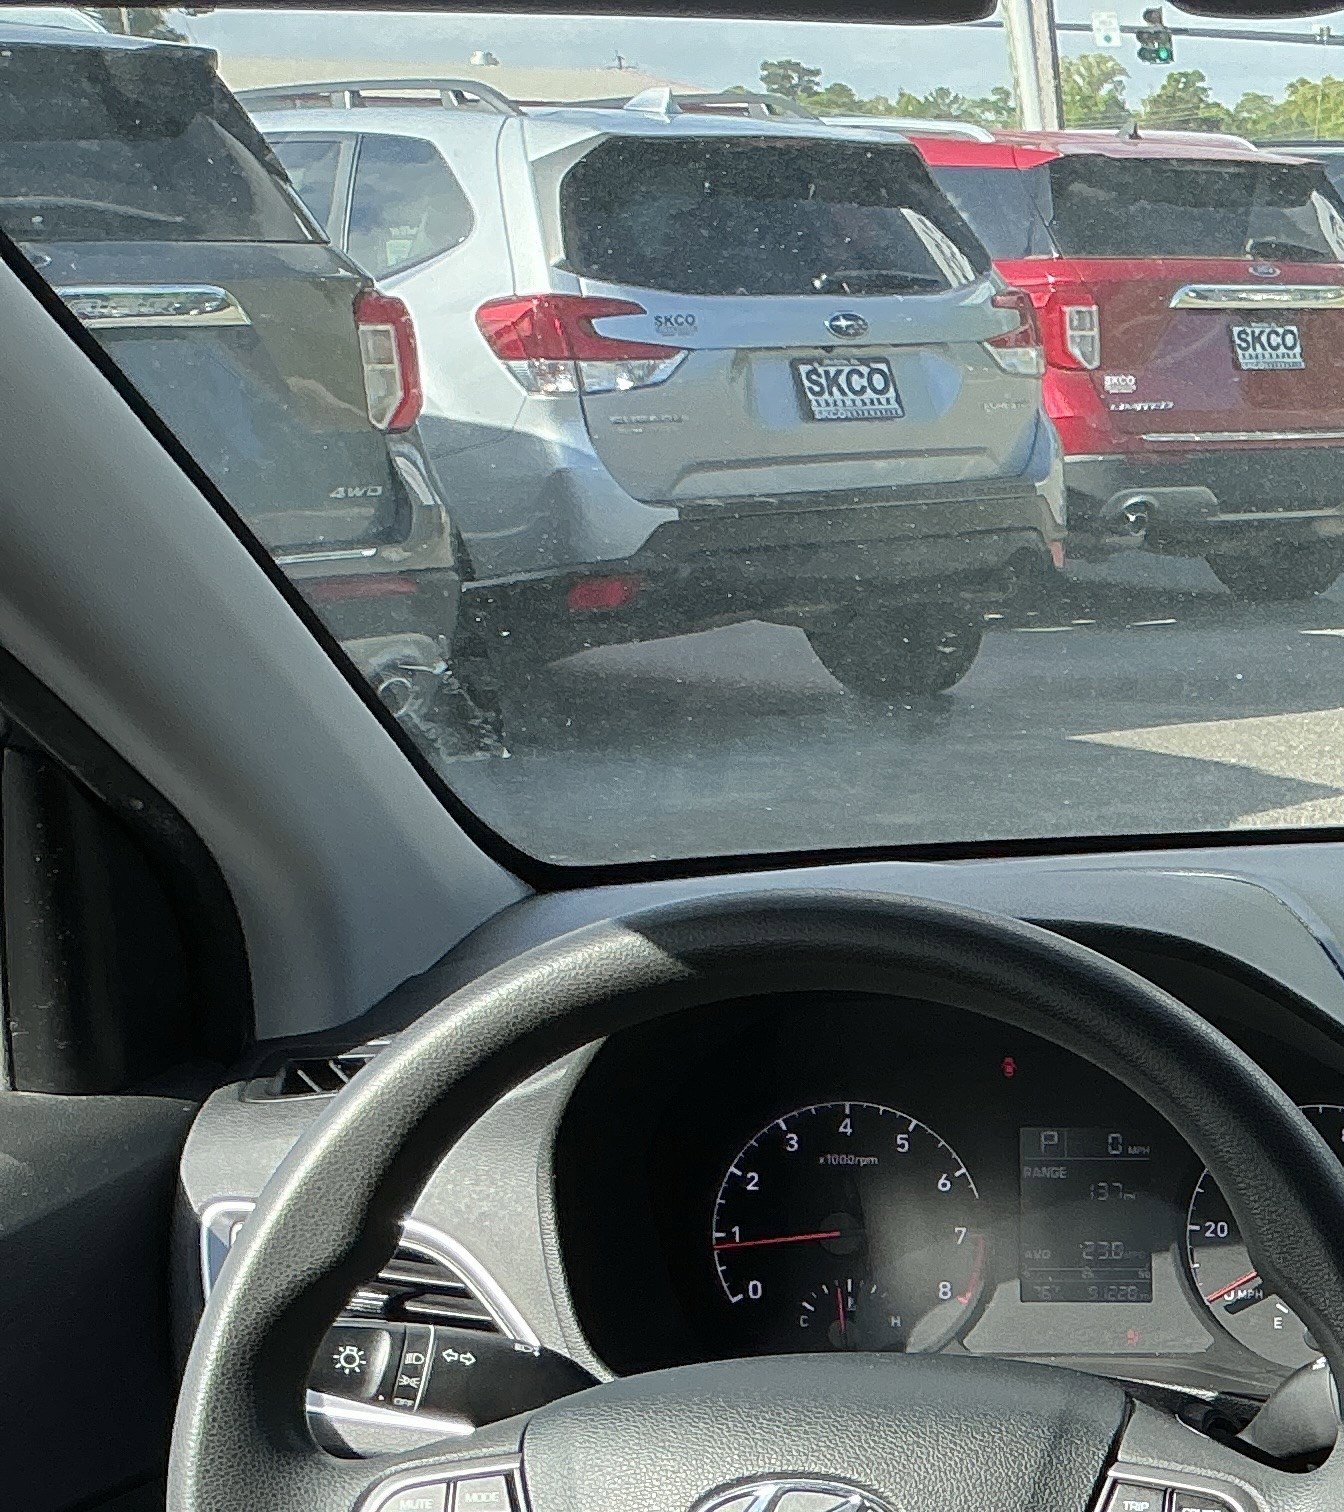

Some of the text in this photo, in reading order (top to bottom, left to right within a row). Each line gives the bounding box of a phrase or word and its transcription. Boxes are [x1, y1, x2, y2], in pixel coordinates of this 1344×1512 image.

[654, 314, 696, 327] SKCO
[1236, 329, 1298, 351] SKCO
[805, 367, 891, 397] SKCO
[329, 484, 383, 498] 4WD
[837, 1117, 853, 1136] 4
[786, 1134, 799, 1152] 3
[896, 1134, 909, 1153] 5
[1040, 1131, 1058, 1153] P
[1107, 1133, 1122, 1154] 0
[746, 1172, 760, 1191] 2
[1023, 1166, 1067, 1179] RANGE
[937, 1173, 952, 1192] 6
[731, 1226, 741, 1243] 1
[954, 1227, 968, 1244] 7
[1204, 1222, 1229, 1238] 20
[748, 1281, 762, 1299] 0
[938, 1281, 953, 1299] 8
[1237, 1288, 1264, 1300] MPH
[1273, 1317, 1283, 1329] E
[400, 1498, 434, 1510] MUTE
[1123, 1501, 1150, 1512] TRIP
